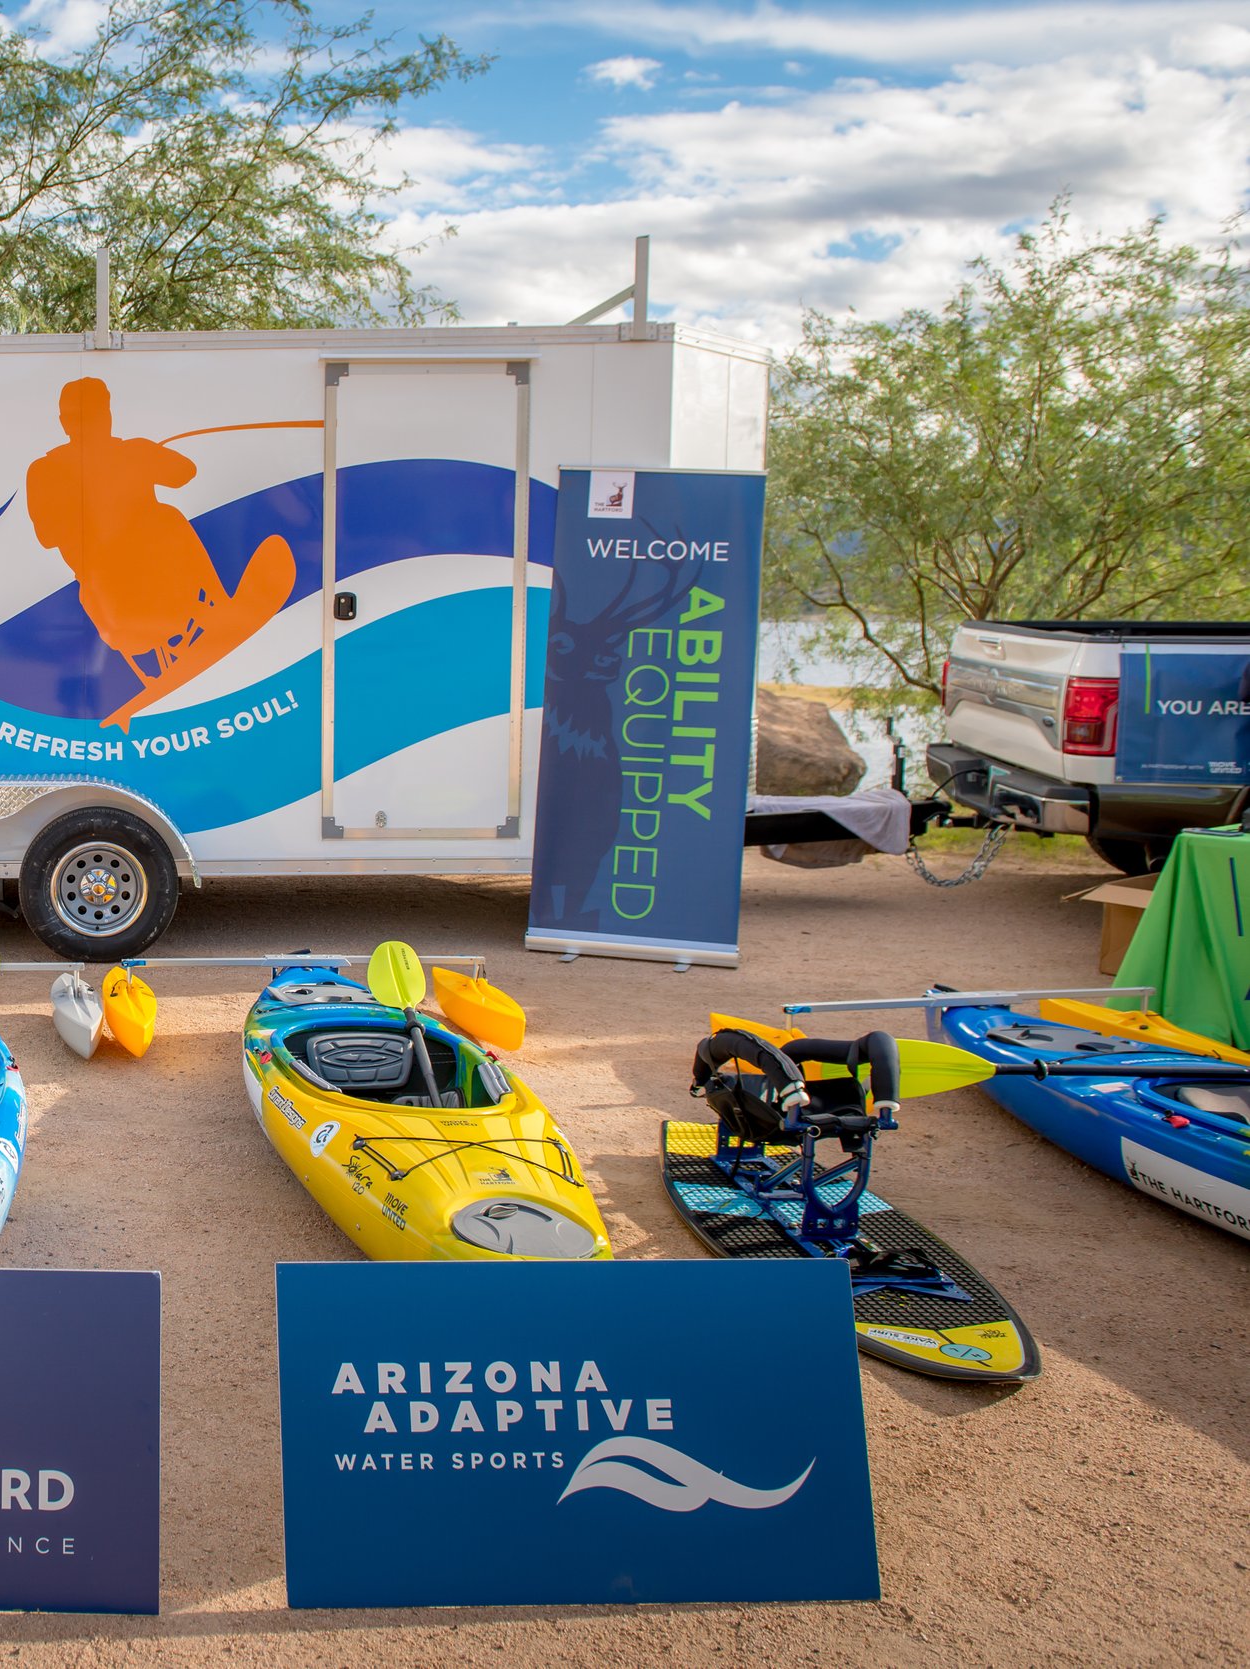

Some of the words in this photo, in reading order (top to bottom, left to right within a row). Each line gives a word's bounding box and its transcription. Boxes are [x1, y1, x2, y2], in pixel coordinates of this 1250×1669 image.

[587, 538, 729, 562] WELCOME
[667, 586, 725, 820] ABILITY
[1157, 700, 1202, 715] YOU
[1207, 700, 1250, 715] ARE
[132, 726, 211, 758] YOUR
[216, 690, 299, 739] SOUL!
[611, 628, 673, 920] EQUIPPED
[342, 1155, 373, 1190] Solara
[352, 1181, 365, 1195] 120
[381, 1203, 407, 1232] UNITED
[385, 1192, 408, 1215] MOVE
[1139, 1172, 1167, 1195] THE
[1171, 1187, 1250, 1232] HARTFOR
[331, 1360, 608, 1394] ARIZONA
[363, 1398, 673, 1433] ADAPTIVE
[334, 1453, 435, 1470] WATER
[451, 1451, 565, 1469] SPORTS
